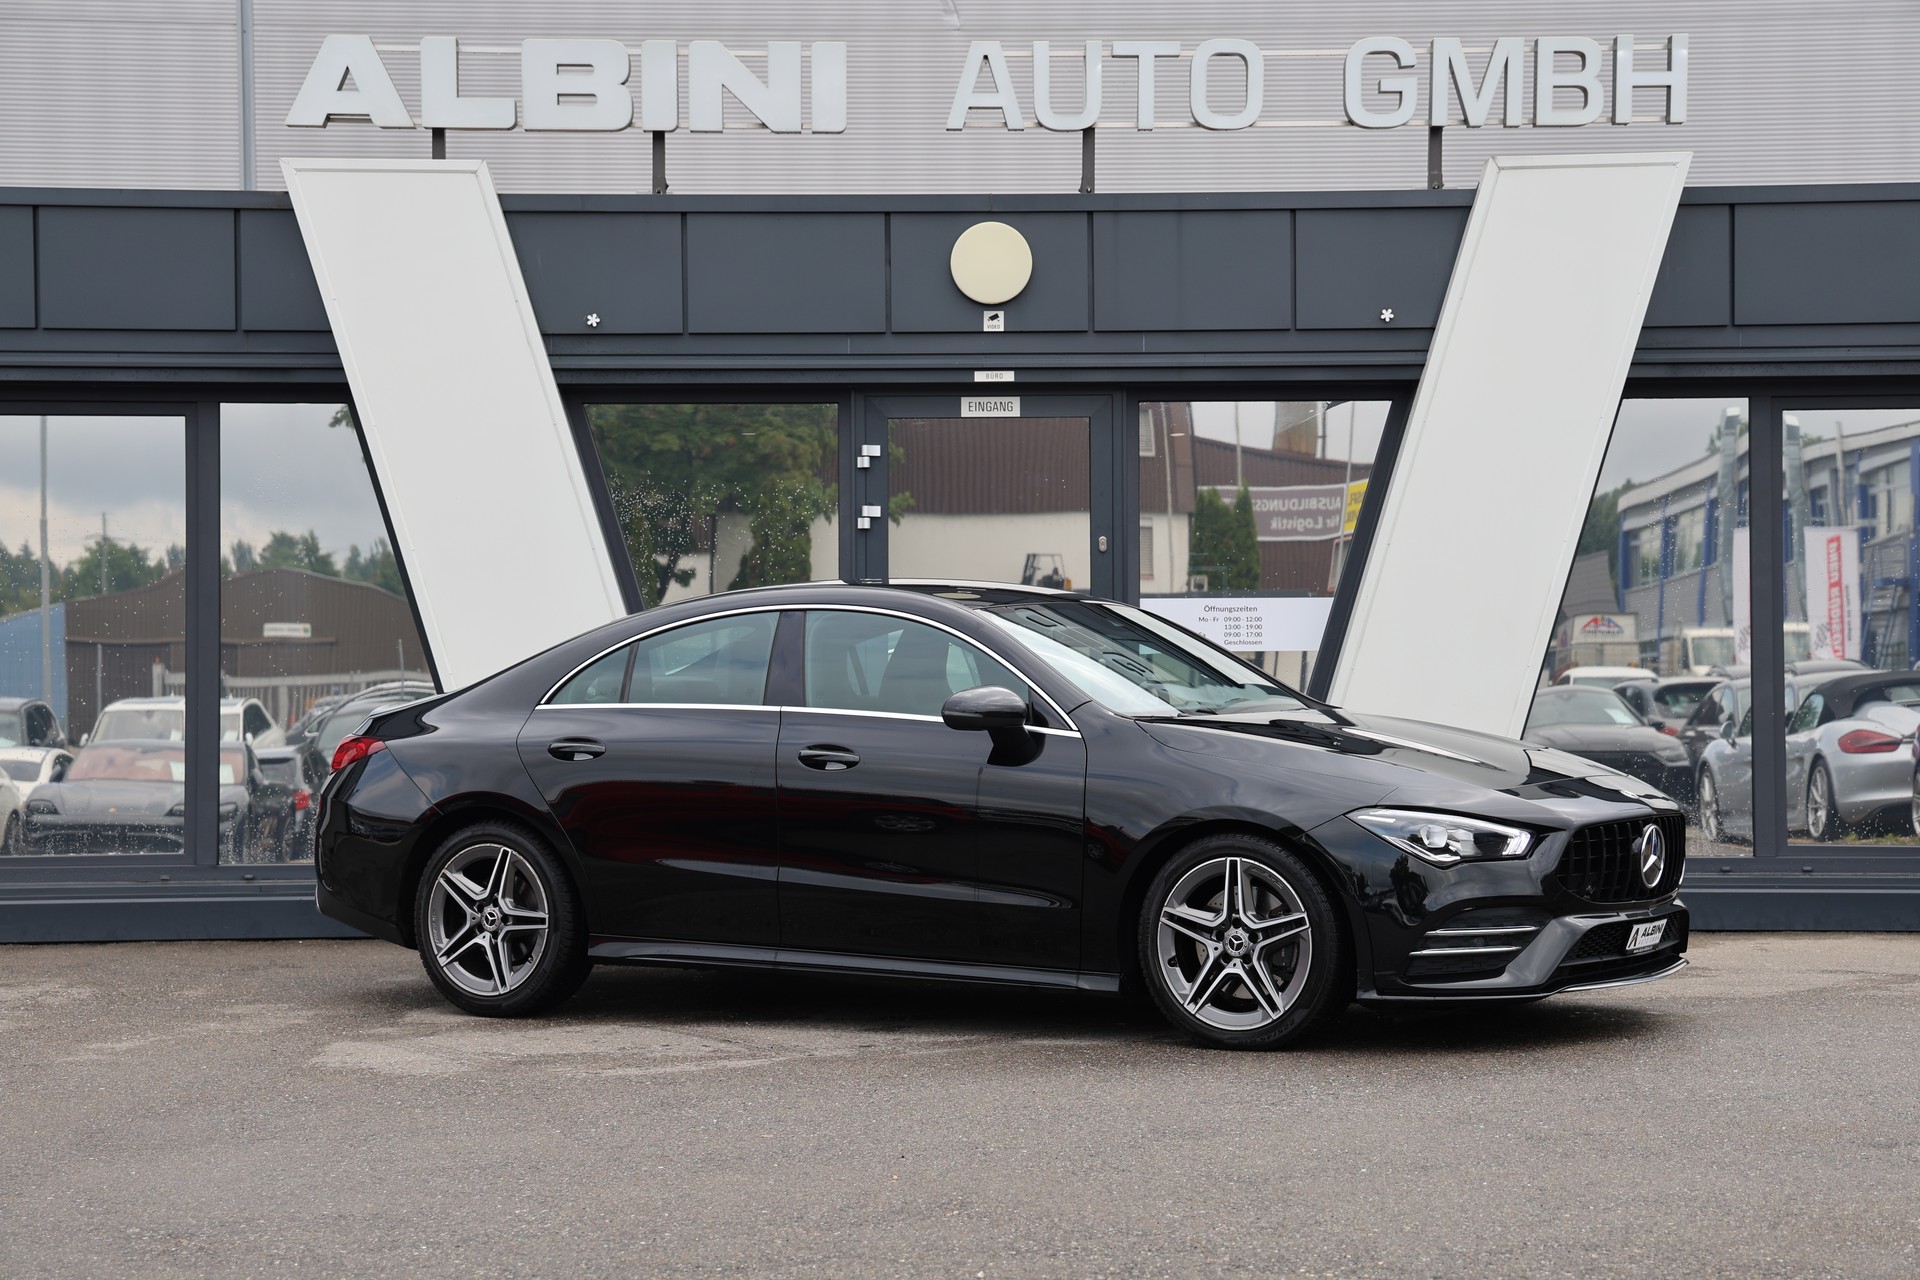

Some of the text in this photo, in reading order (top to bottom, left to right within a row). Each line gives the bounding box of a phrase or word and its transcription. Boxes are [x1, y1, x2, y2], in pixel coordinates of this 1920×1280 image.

[285, 33, 1690, 134] ALBINI AUTO GMBH
[986, 371, 1004, 379] BÜRO
[968, 401, 1014, 412] EINGANG
[1203, 604, 1258, 613] Öffnungszeiten
[1641, 923, 1664, 938] ALBINI
